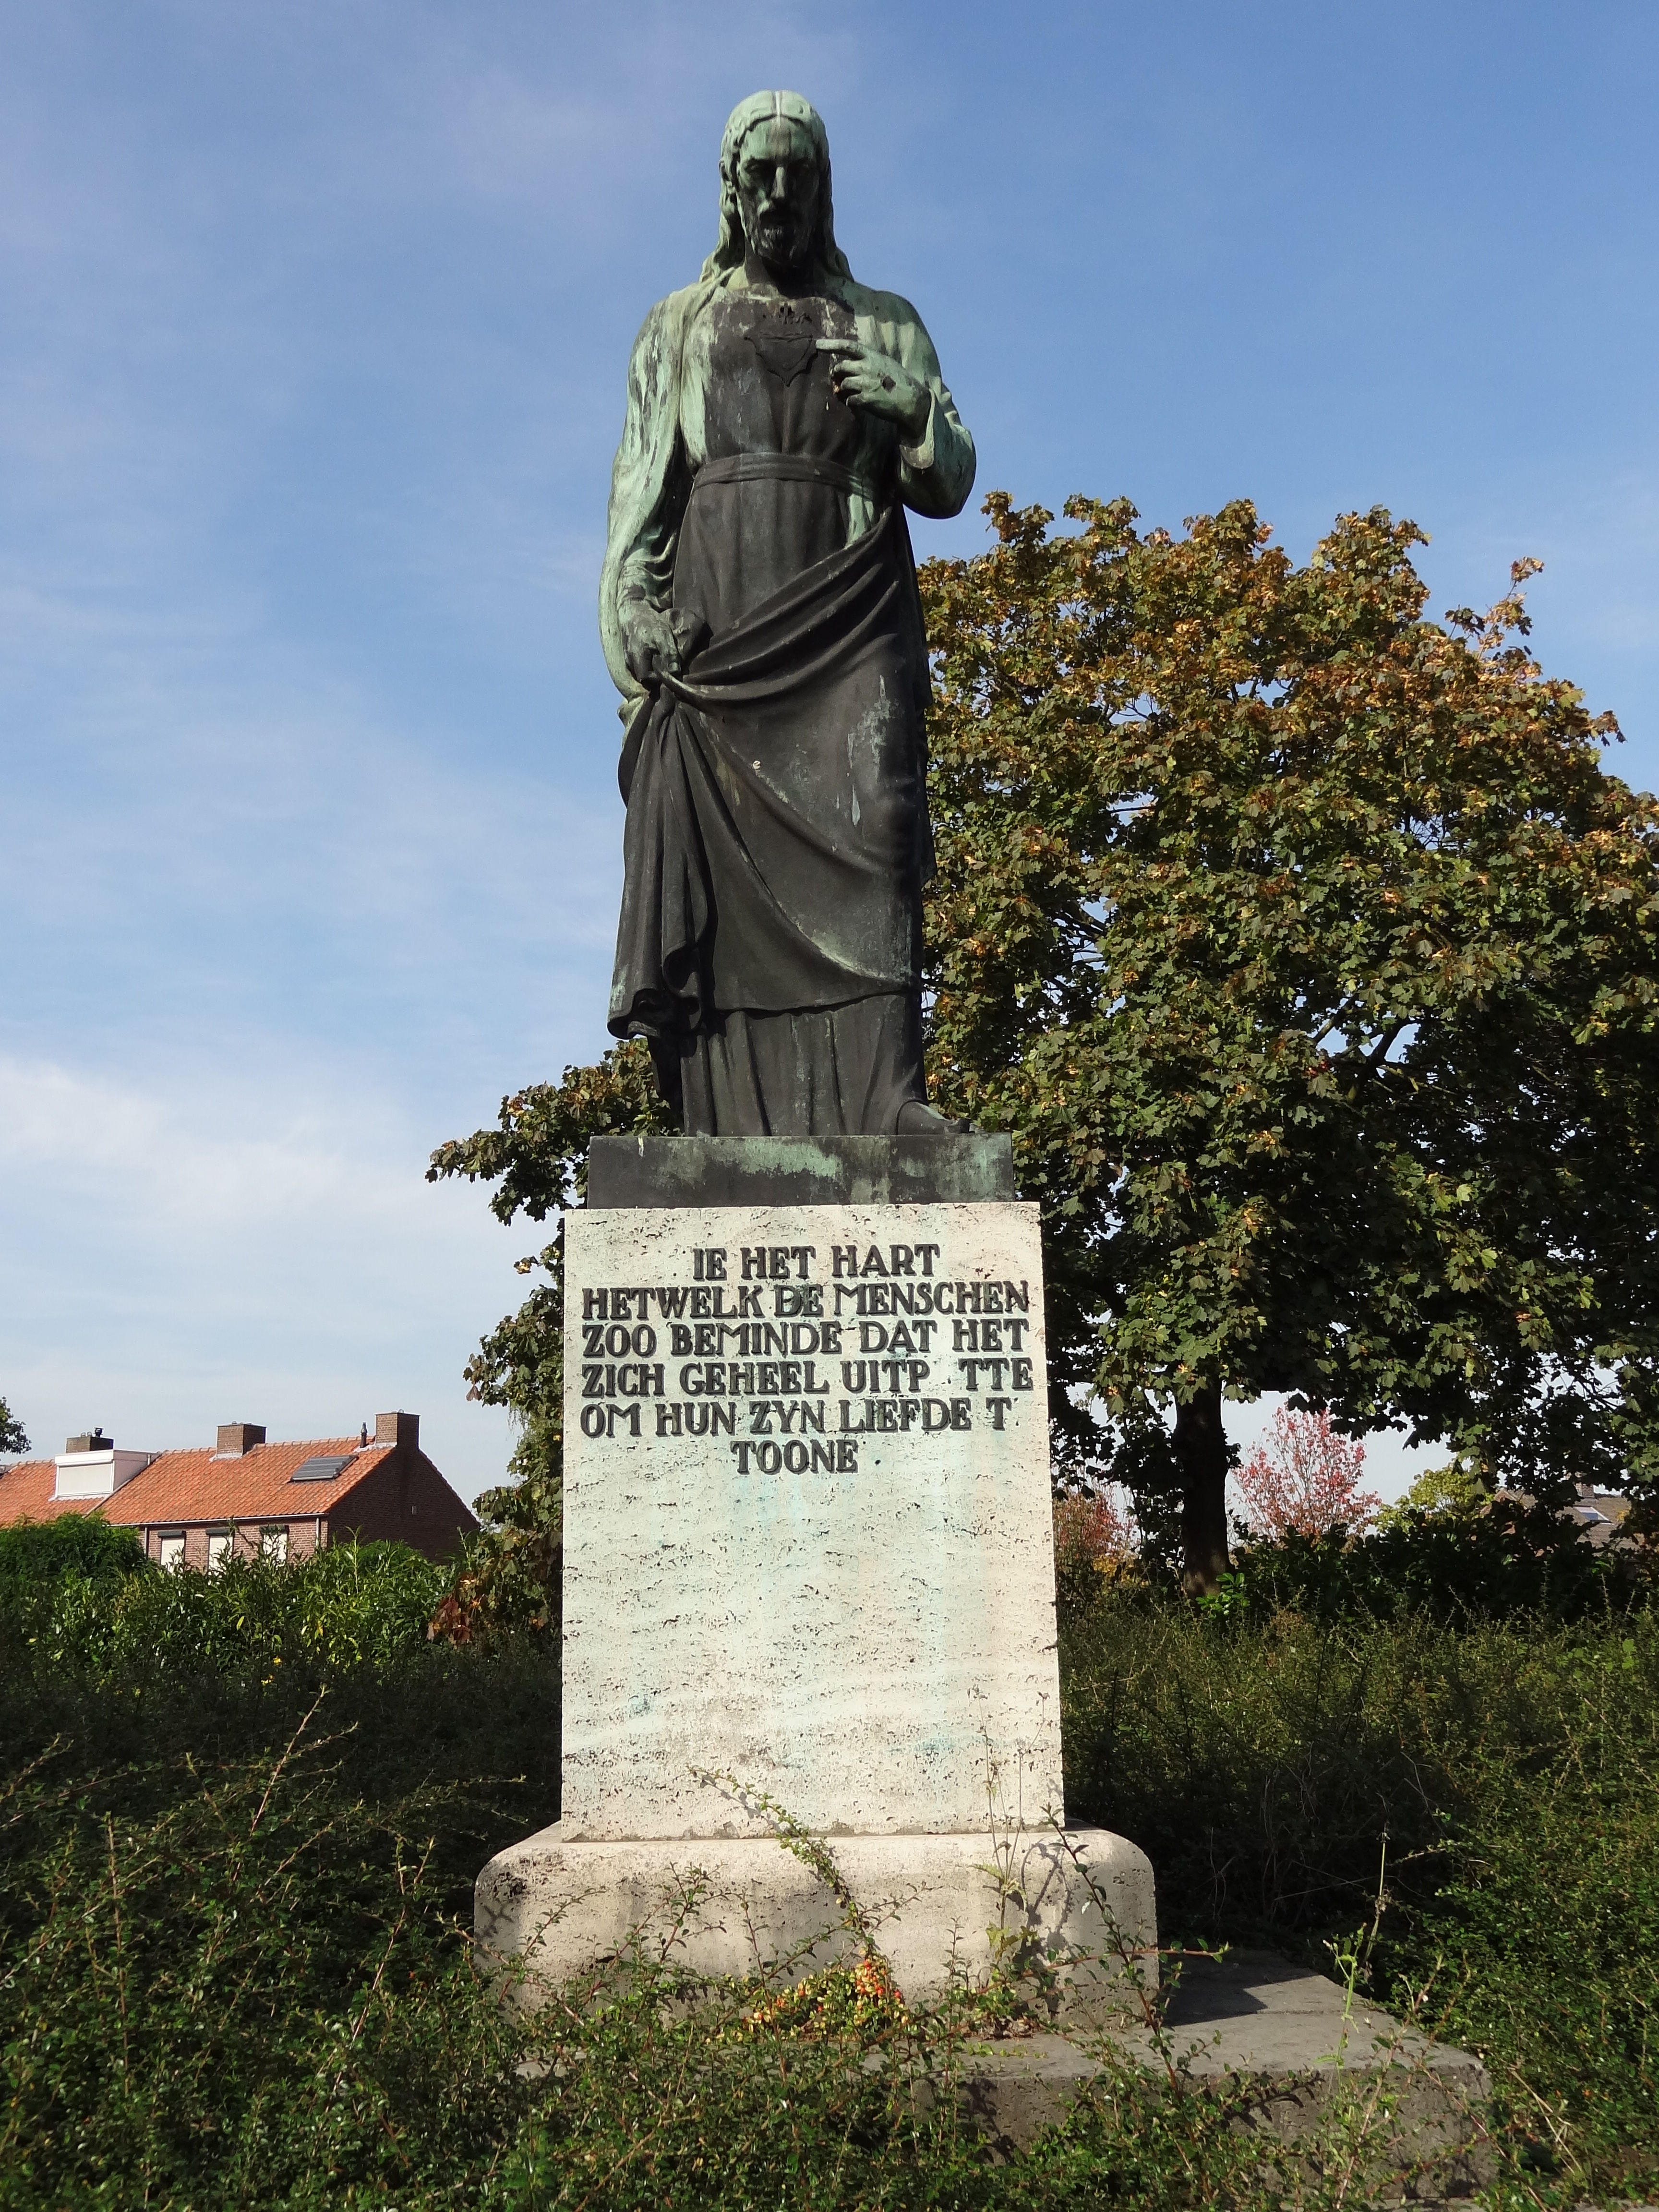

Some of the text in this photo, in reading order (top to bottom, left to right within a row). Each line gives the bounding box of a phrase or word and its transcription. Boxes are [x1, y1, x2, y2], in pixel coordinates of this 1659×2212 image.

[692, 1244, 940, 1282] IE HET HART
[581, 1280, 1030, 1320] HETWELK DE MENSCHEN
[582, 1318, 1030, 1358] ZOO BEMINDE DAT HET
[581, 1363, 666, 1398] ZICH
[679, 1360, 830, 1396] GEHEEL
[580, 1397, 1012, 1438] OM HUN ZYN LIEFDE T
[731, 1439, 859, 1475] TOONE
